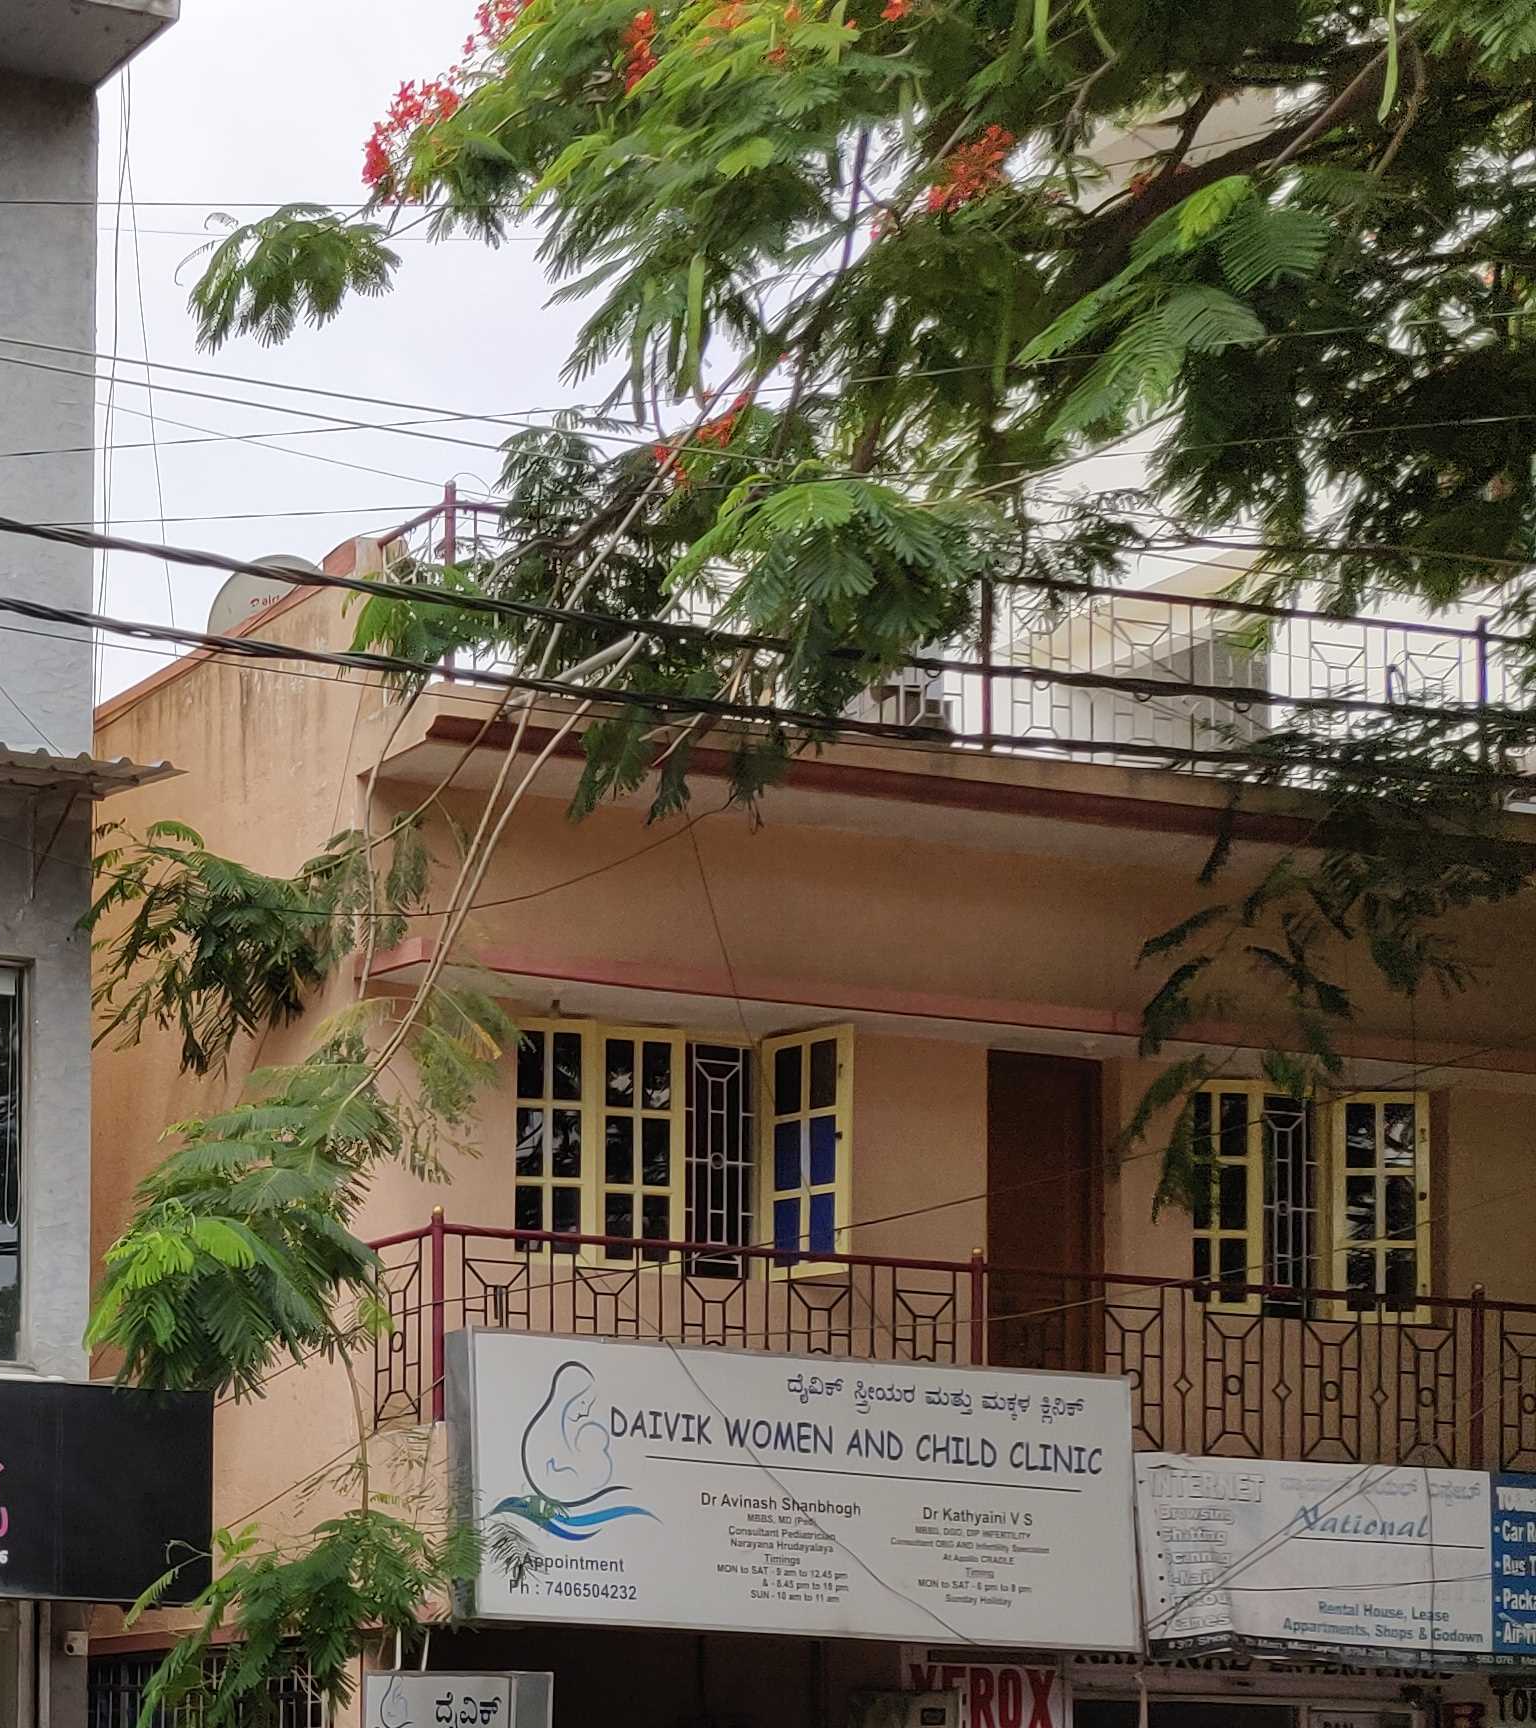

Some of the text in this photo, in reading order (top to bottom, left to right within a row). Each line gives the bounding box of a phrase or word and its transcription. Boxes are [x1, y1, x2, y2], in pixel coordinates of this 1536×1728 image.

[610, 1406, 1104, 1476] DAIVIK WOMEN AND CHILD CLINIC
[701, 1492, 861, 1518] Dr Avinash Shanbhogh
[923, 1506, 1033, 1526] Dr Kathyaini V S
[1285, 1505, 1429, 1538] National
[728, 1525, 779, 1538] Consultant
[1502, 1520, 1524, 1543] Car
[730, 1538, 774, 1550] Narayana
[523, 1552, 624, 1573] Appointment
[717, 1564, 738, 1573] MON
[751, 1566, 769, 1575] SAT
[764, 1554, 801, 1566] Timings
[1502, 1554, 1526, 1577] Bus
[509, 1579, 638, 1601] Ph 7406504232
[750, 1590, 770, 1600] SUN
[952, 1580, 970, 1590] SAT
[1319, 1601, 1449, 1622] Rental House, Lease
[1375, 1623, 1414, 1640] Shops
[1418, 1625, 1427, 1639] &
[1433, 1628, 1484, 1643] Godown
